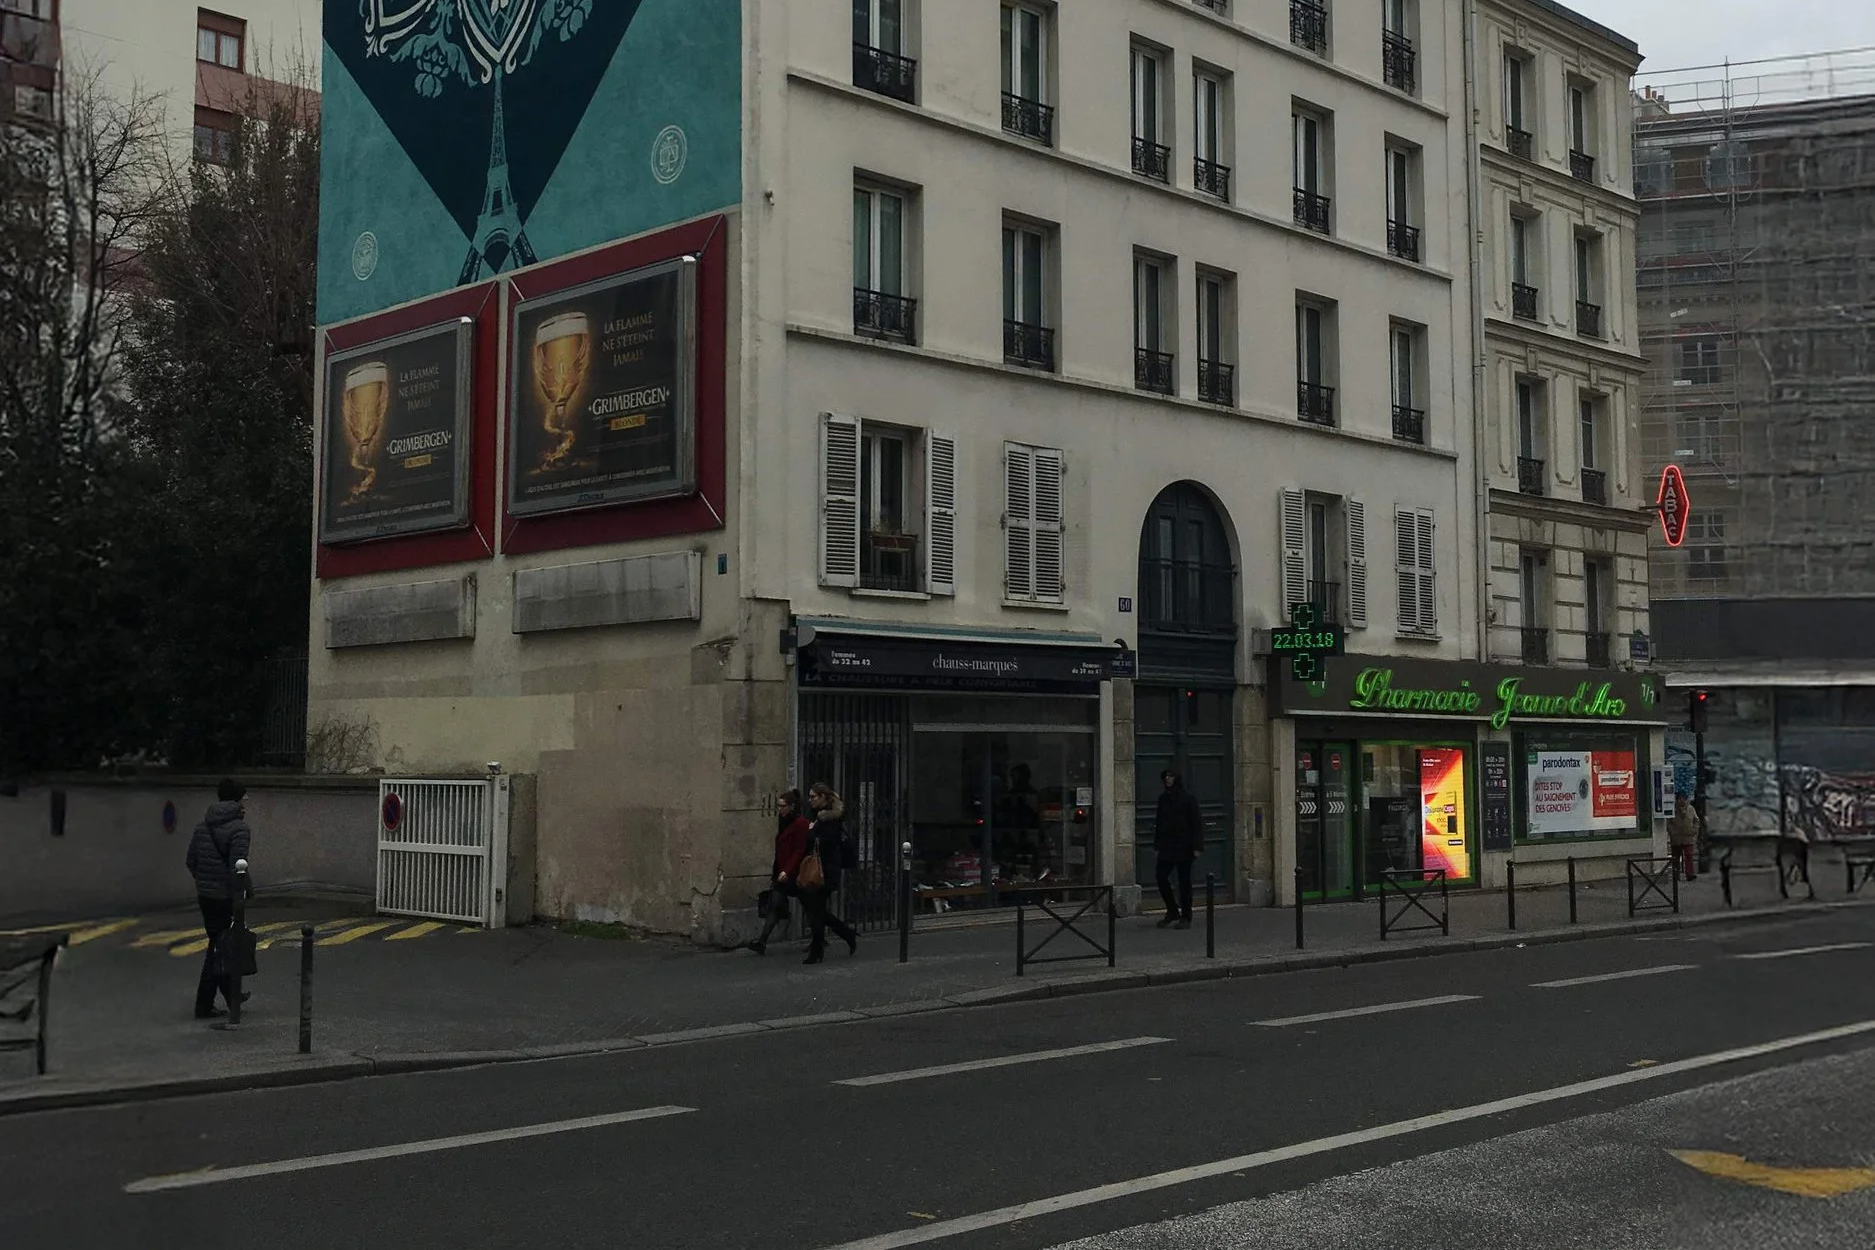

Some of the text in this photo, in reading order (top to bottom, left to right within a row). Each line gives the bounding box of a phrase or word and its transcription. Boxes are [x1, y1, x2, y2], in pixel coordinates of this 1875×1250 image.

[604, 312, 653, 334] LA FLAMME
[602, 339, 615, 352] NE
[592, 386, 666, 415] GRIMBERGEN
[389, 430, 449, 454] GRIMBERGEN
[1665, 474, 1677, 537] TABAC
[1119, 598, 1131, 611] 60
[1273, 632, 1335, 649] 22.03.18
[1349, 666, 1481, 713] Pharmacie
[1490, 677, 1566, 730] Jeanne
[1568, 681, 1628, 717] d'Arc
[1640, 682, 1656, 705] 7/7
[1542, 755, 1581, 772] parodontax
[1549, 781, 1563, 791] STOP
[1535, 792, 1577, 802] AU SAIGNEMENT
[1535, 804, 1545, 813] DES
